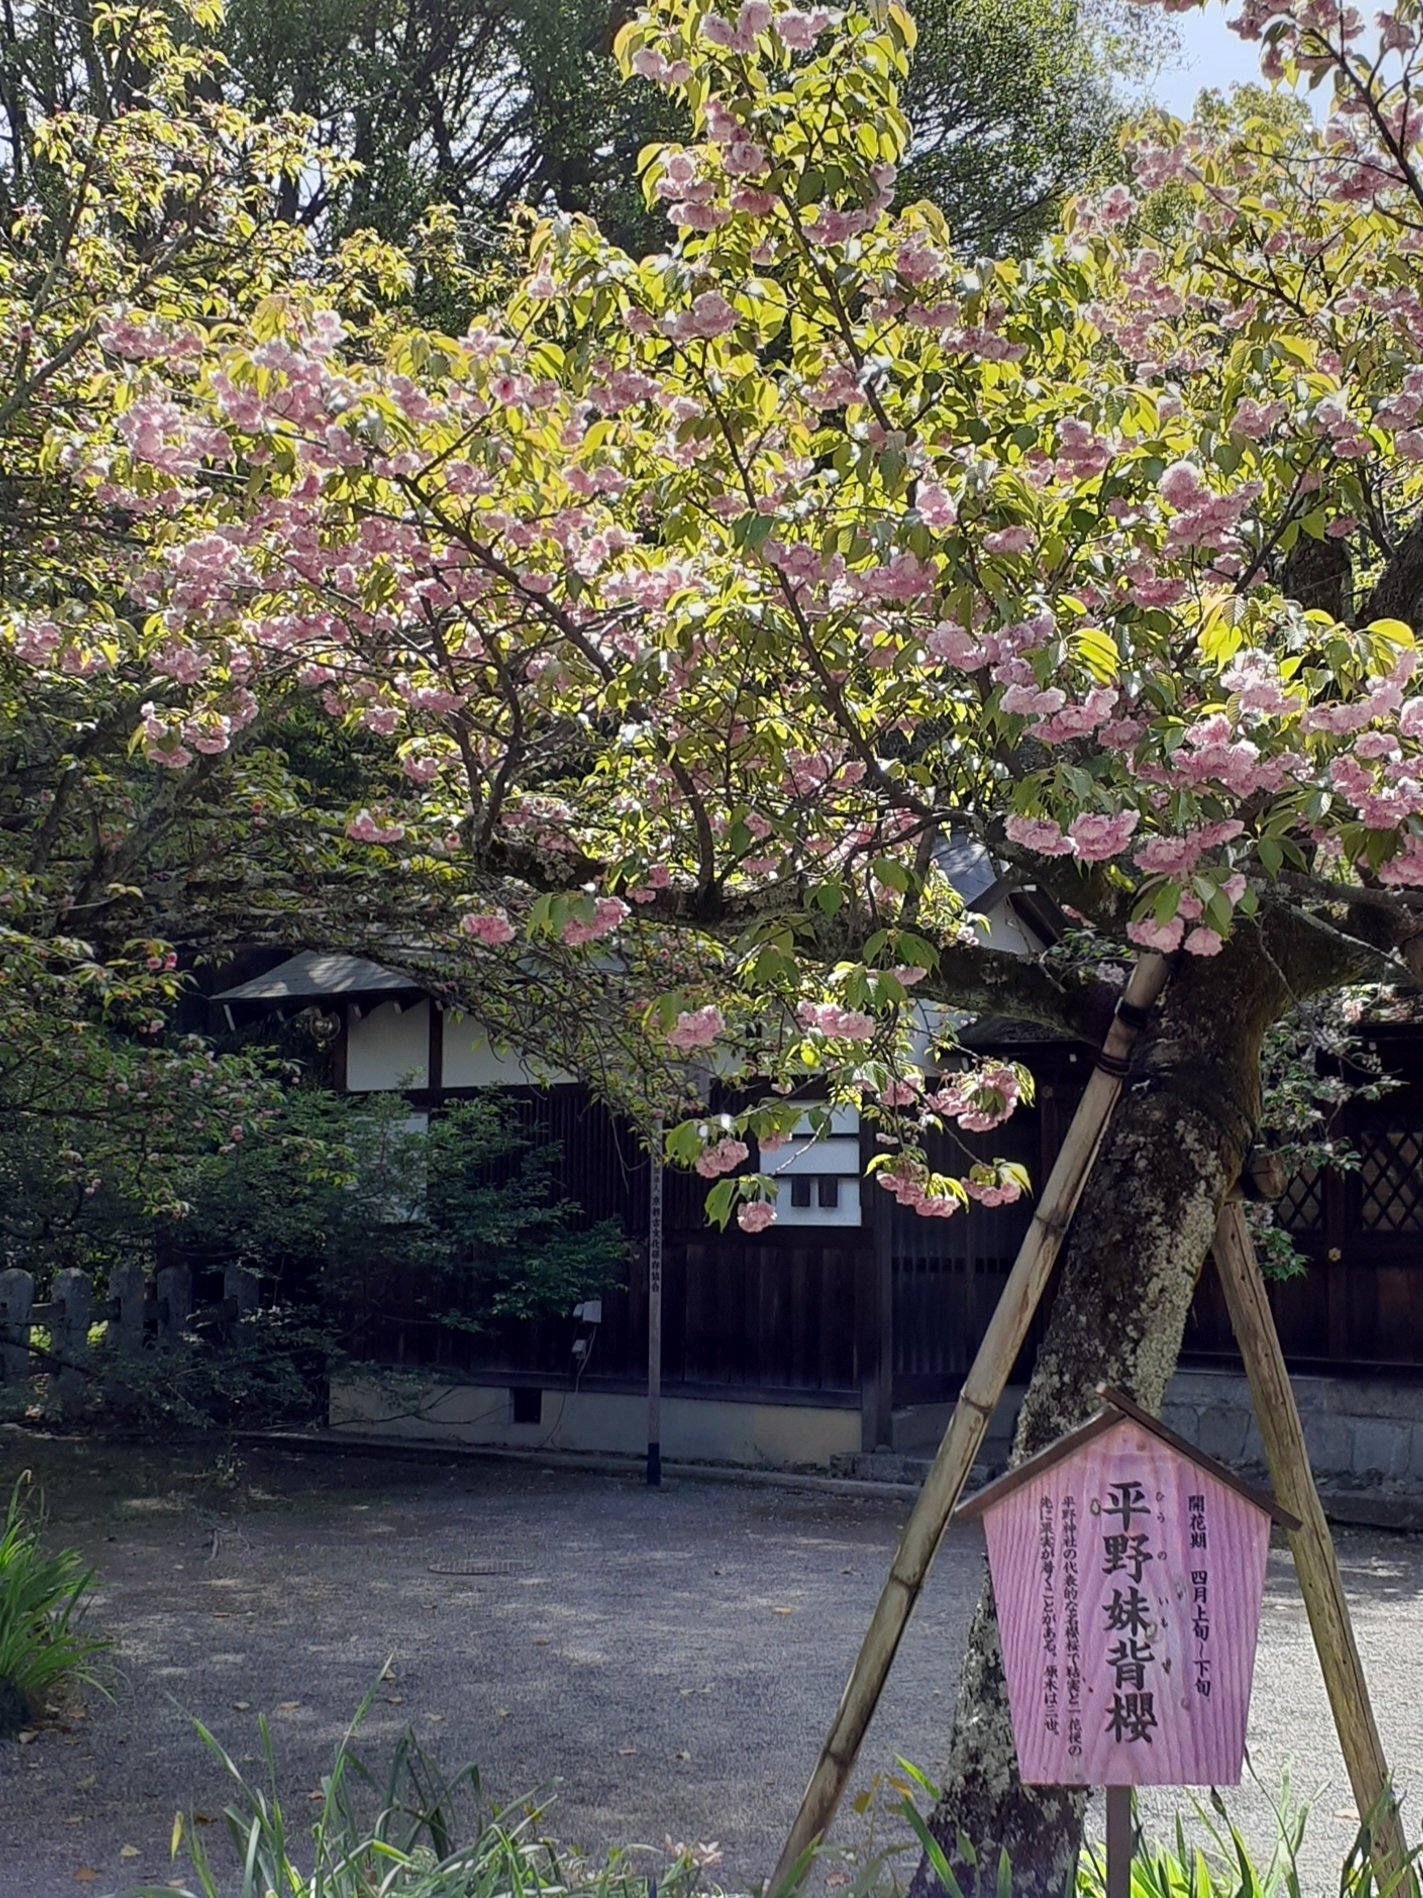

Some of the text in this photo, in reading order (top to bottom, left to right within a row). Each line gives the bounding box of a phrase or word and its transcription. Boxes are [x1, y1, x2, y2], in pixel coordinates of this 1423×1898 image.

[1188, 1495, 1208, 1550] 開花期
[1101, 1480, 1158, 1745] 平野妹背櫻
